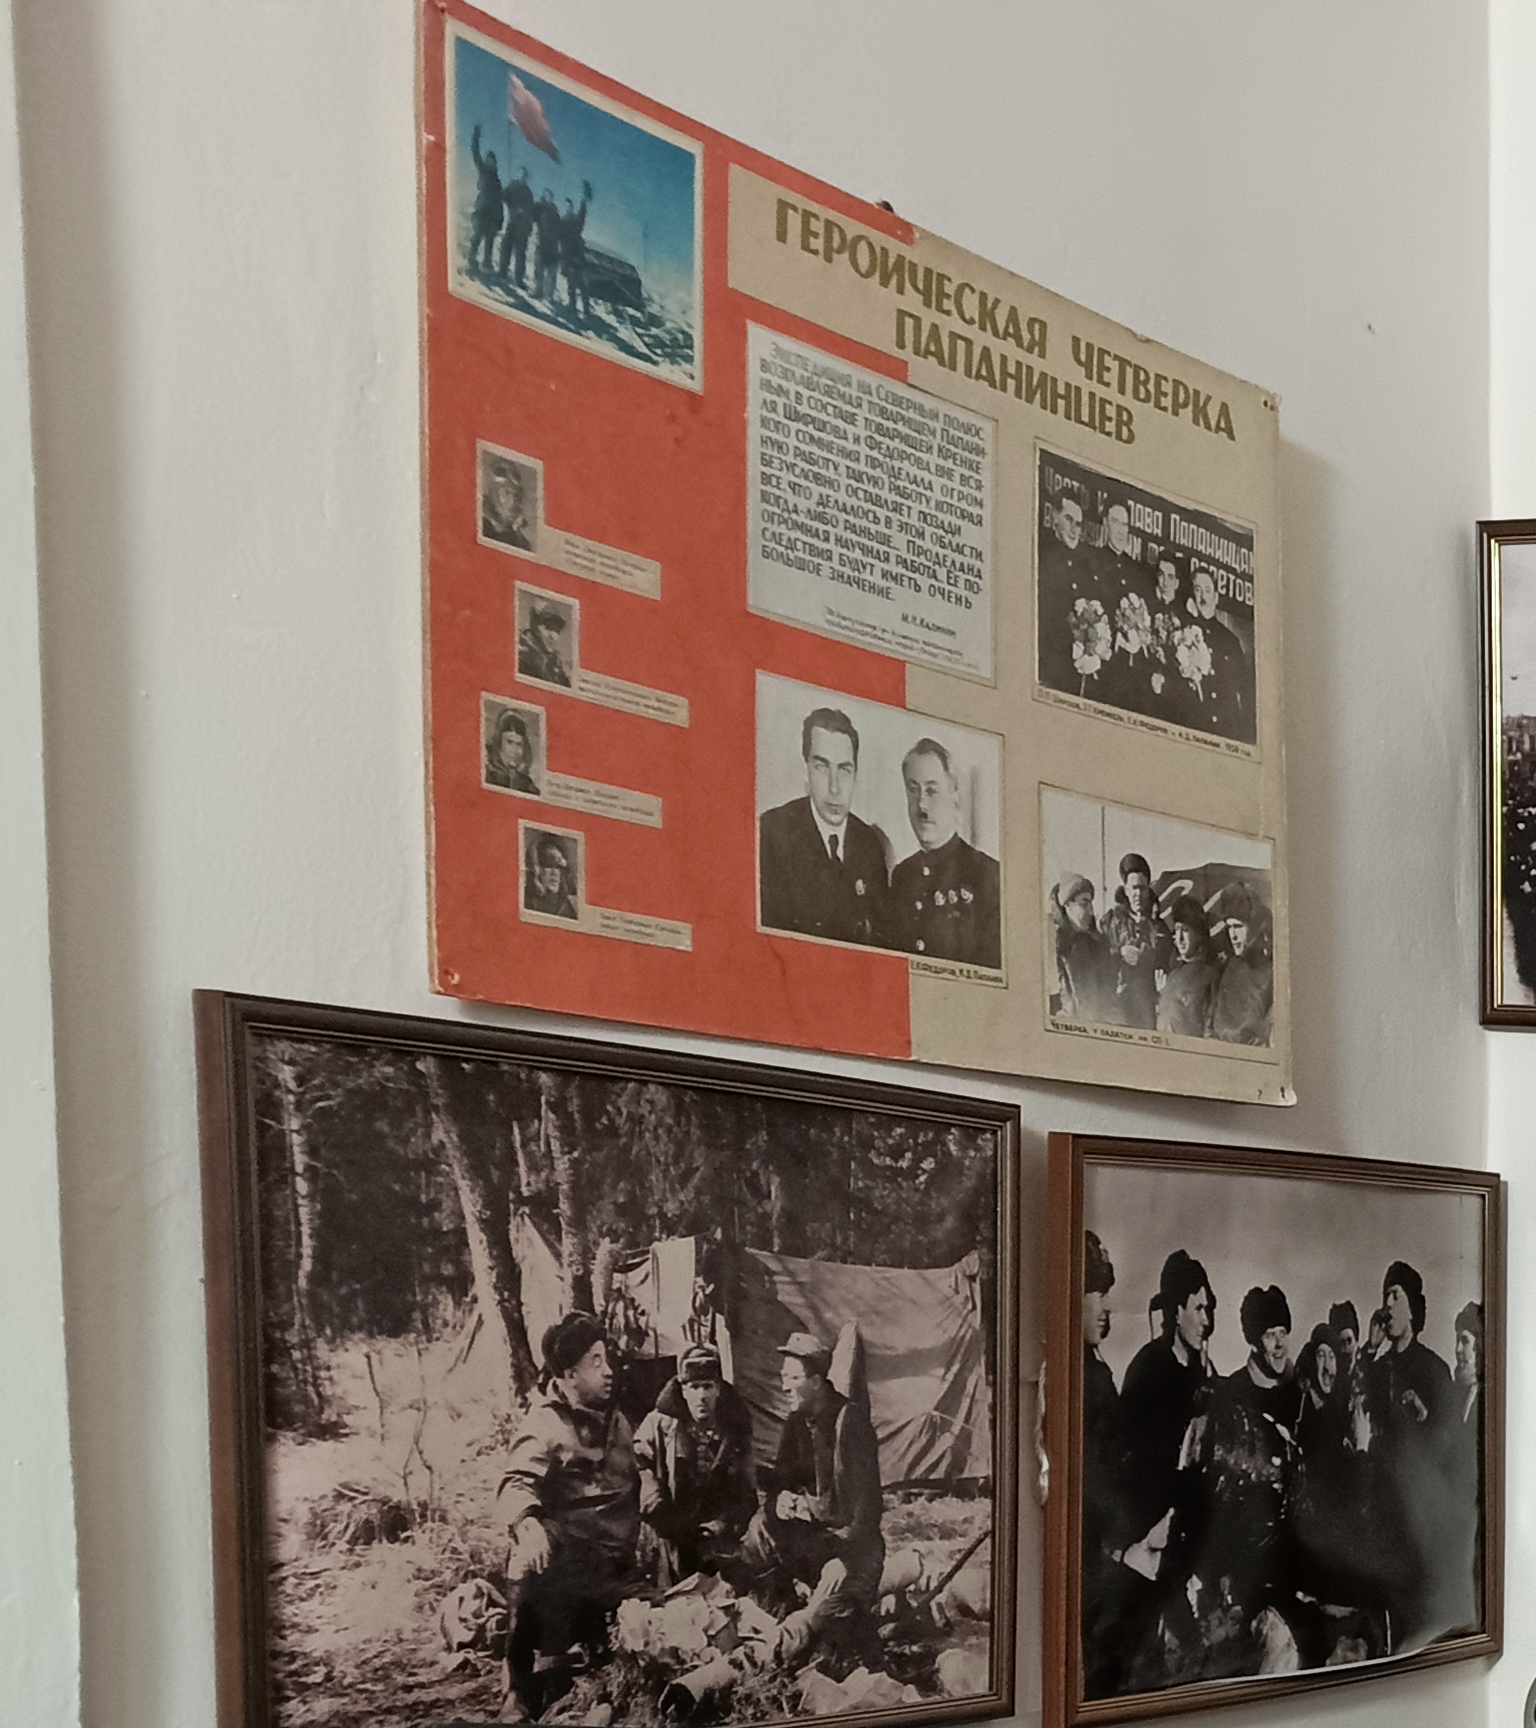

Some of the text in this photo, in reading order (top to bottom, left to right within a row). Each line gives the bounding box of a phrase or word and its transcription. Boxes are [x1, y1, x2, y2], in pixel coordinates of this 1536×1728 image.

[776, 197, 1235, 442] ГЕРОИЧЕСКАЯ ЧЕТВЕРКА
[894, 308, 1136, 445] ПАПАНИНЦЕВ
[759, 431, 982, 529] НУЮ ТАКУЮ КОТОРАЯ
[760, 450, 961, 538] БЕЗУСЛОВНО ОСТАВЛЯЕТ ПОЗАДИ
[787, 478, 925, 545] ЧТО ДЕЛАЛОСЬ В ЭТОЙ
[864, 452, 933, 495] ПРОДЕЛАЛА
[760, 505, 830, 546] ОГРОМНАЯ
[834, 530, 890, 566] НАУЧНАЯ
[761, 543, 822, 578] БОЛЬШОЕ
[761, 524, 972, 612] СЛЕДСТВИЯ БУДУТ ИМЕТЬ ОЧЕНЬ
[906, 538, 982, 582] ПРОДЕЛАНА
